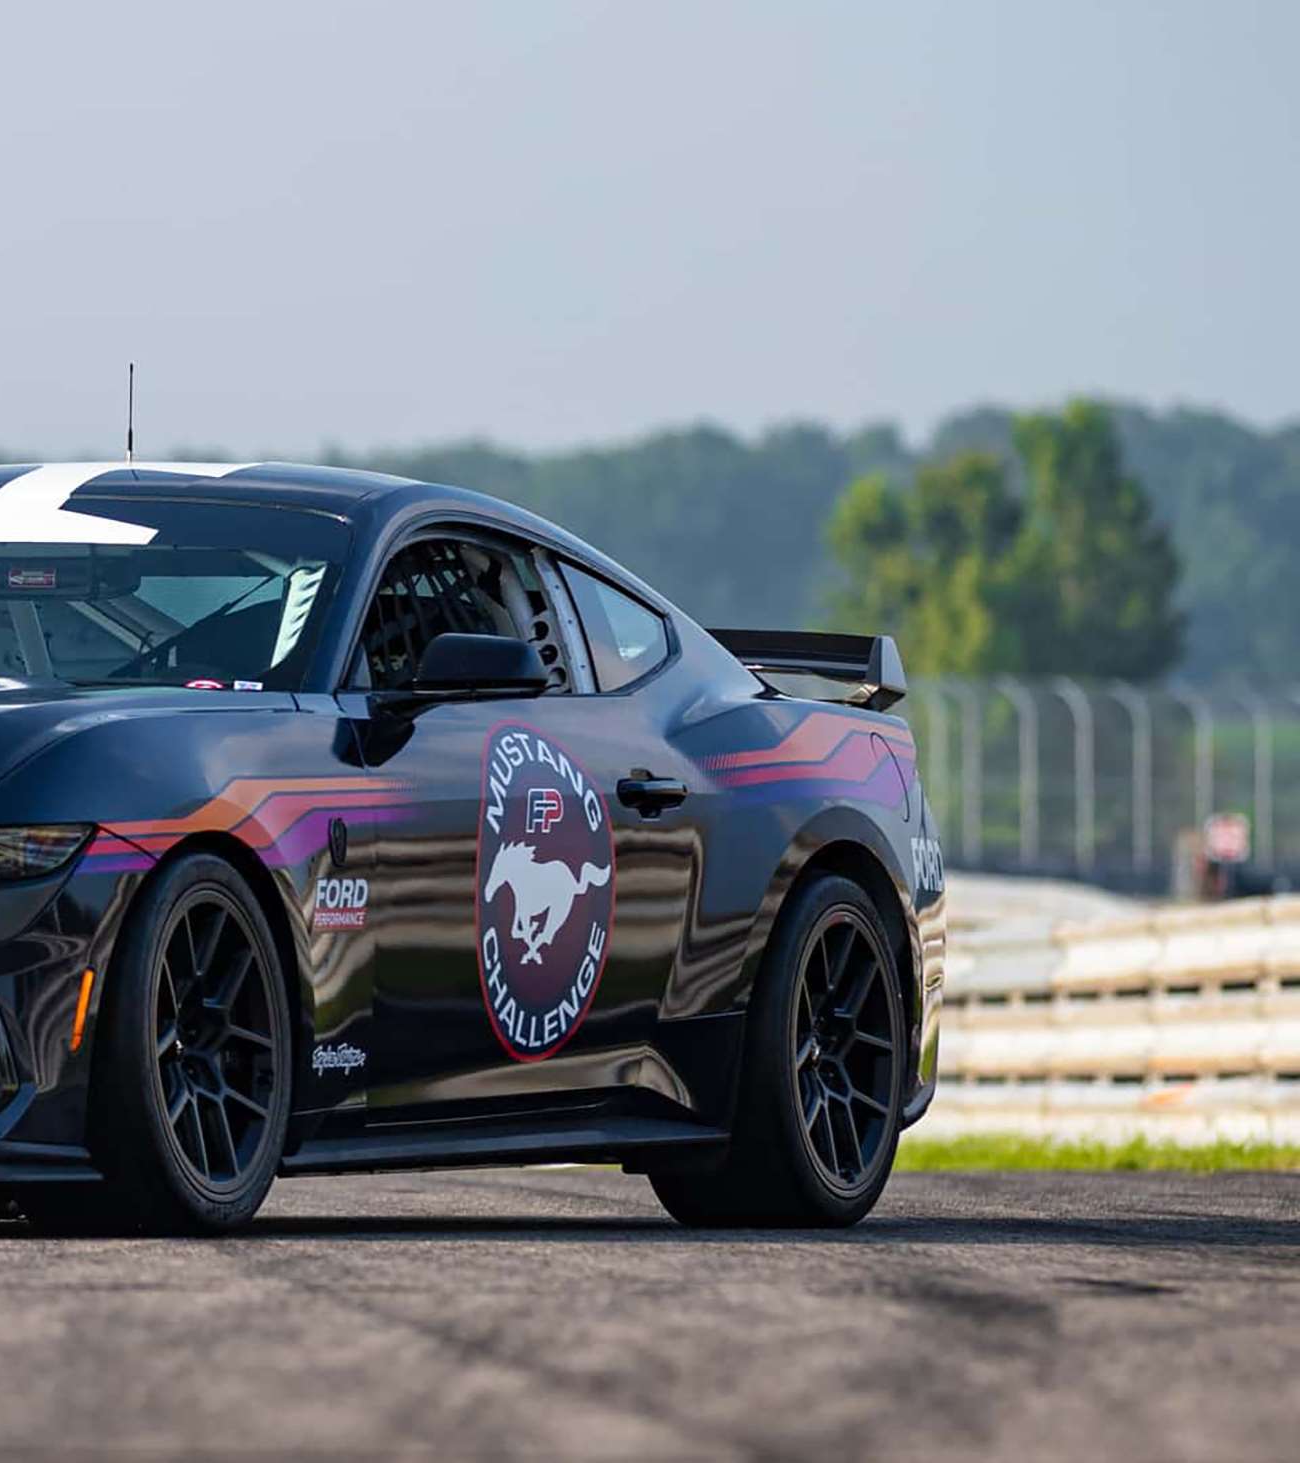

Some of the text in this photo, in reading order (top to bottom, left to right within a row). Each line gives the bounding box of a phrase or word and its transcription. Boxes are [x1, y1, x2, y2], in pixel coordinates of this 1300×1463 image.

[485, 732, 602, 835] MUSTANG
[525, 788, 564, 833] FP
[910, 837, 944, 892] FORD
[315, 878, 368, 908] FORD
[315, 912, 364, 925] PERFORMANCE
[483, 922, 606, 1047] CHALLENGE
